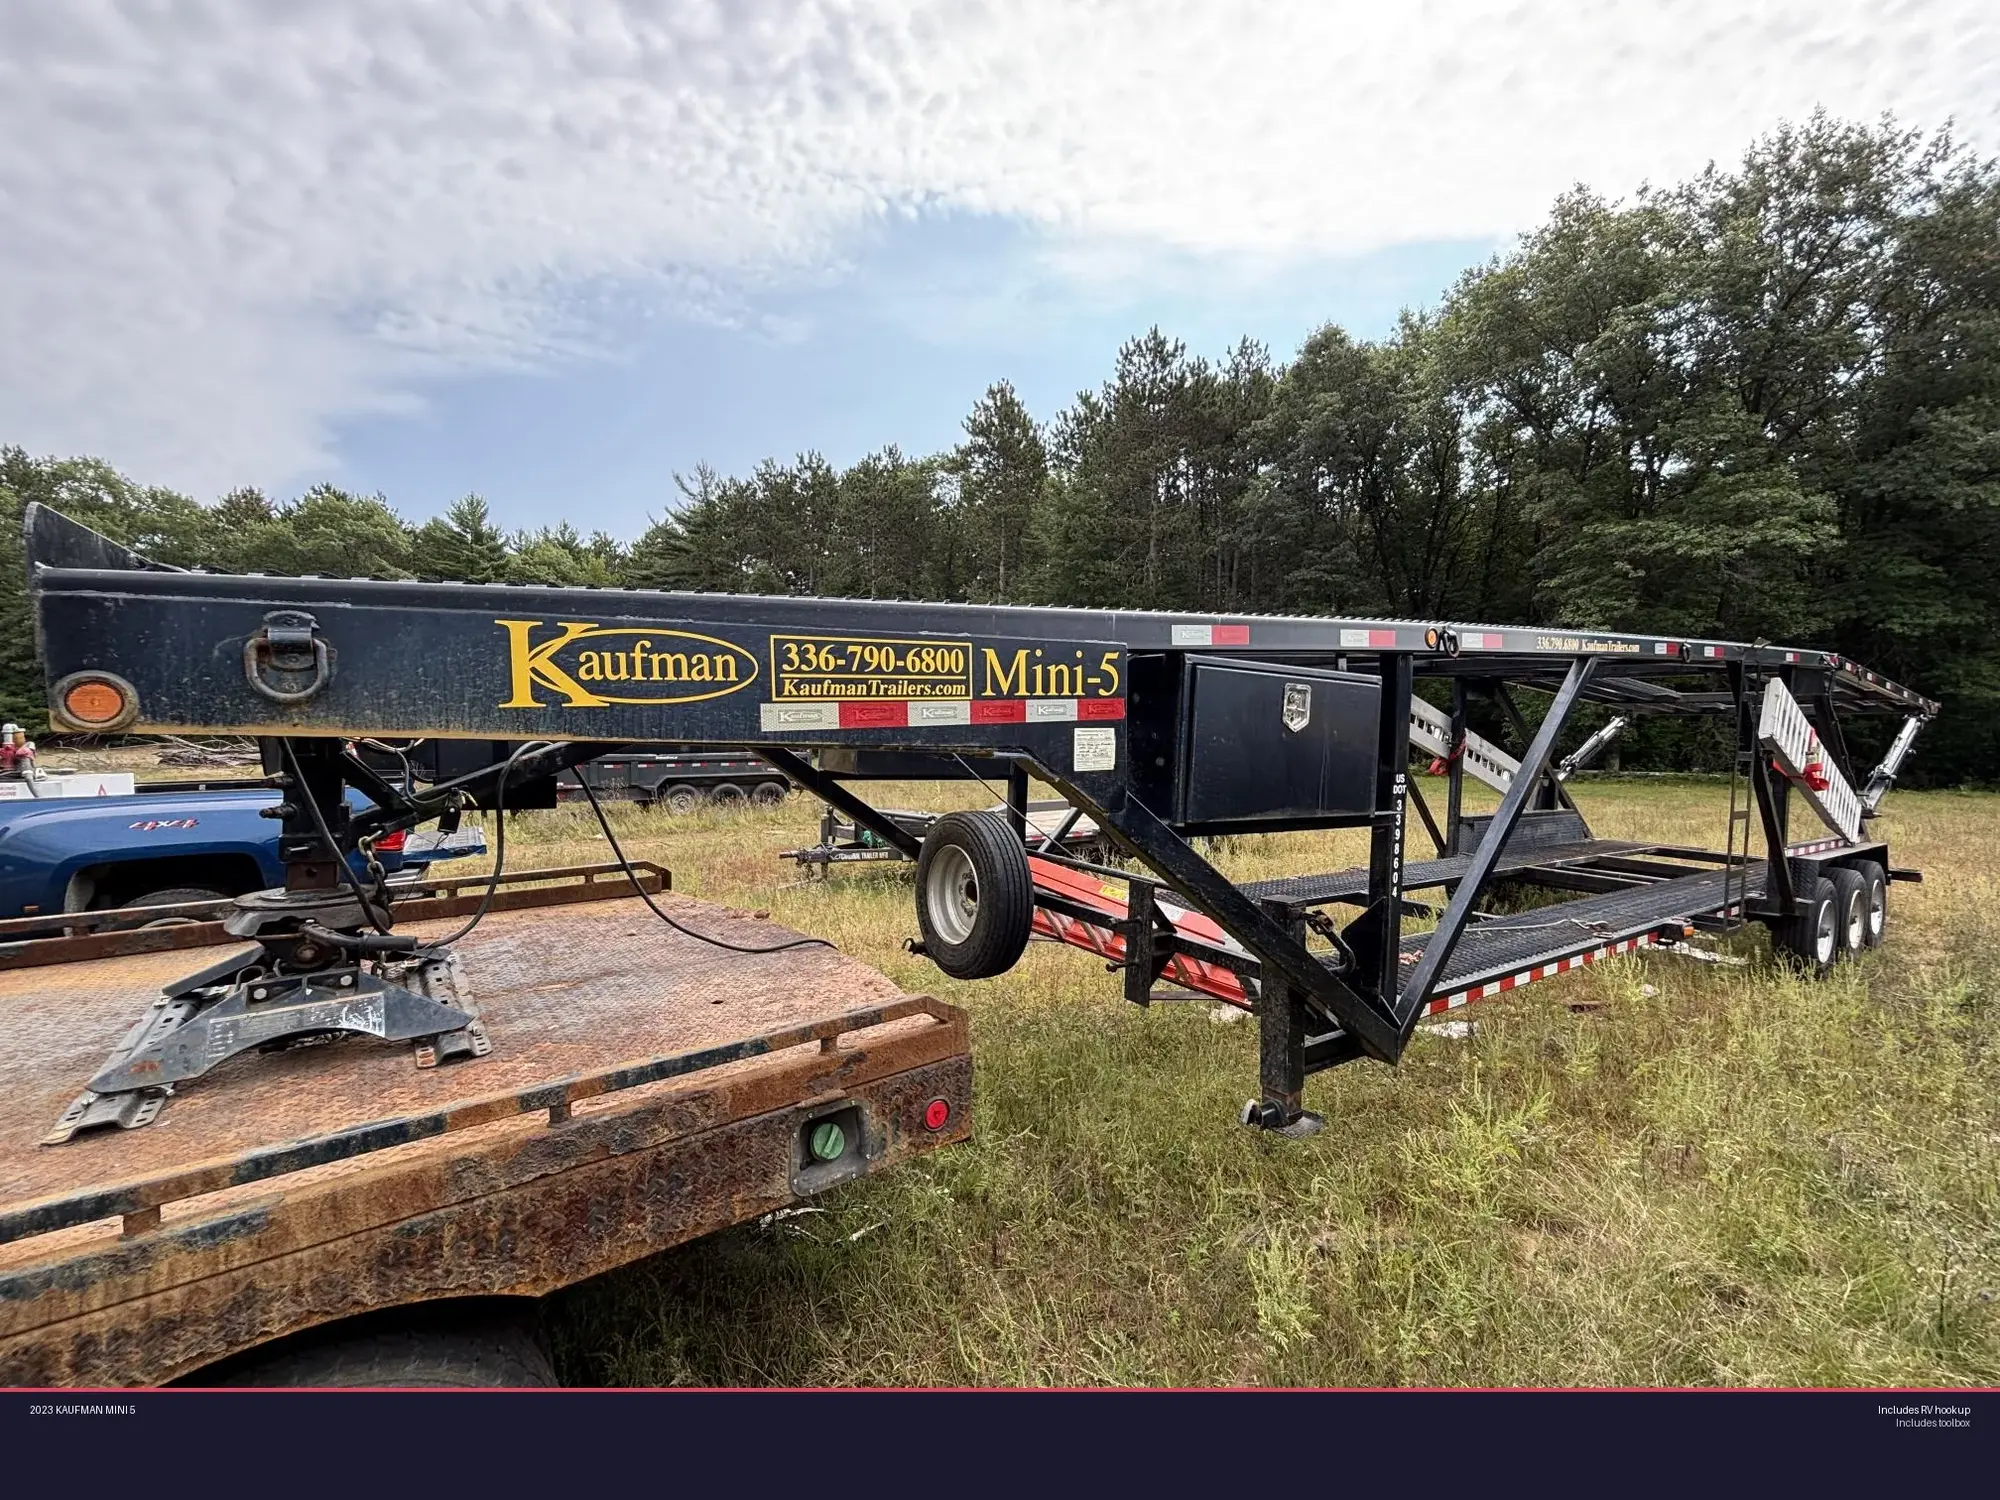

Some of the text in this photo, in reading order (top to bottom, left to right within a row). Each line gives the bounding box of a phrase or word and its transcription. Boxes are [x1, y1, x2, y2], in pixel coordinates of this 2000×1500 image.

[495, 620, 738, 708] Kaufman
[782, 643, 964, 673] 336-790-6800
[981, 649, 1120, 697] Mini-5
[782, 679, 967, 697] KaufmanTrailers.com
[1393, 785, 1407, 794] DOT
[1395, 774, 1405, 783] US
